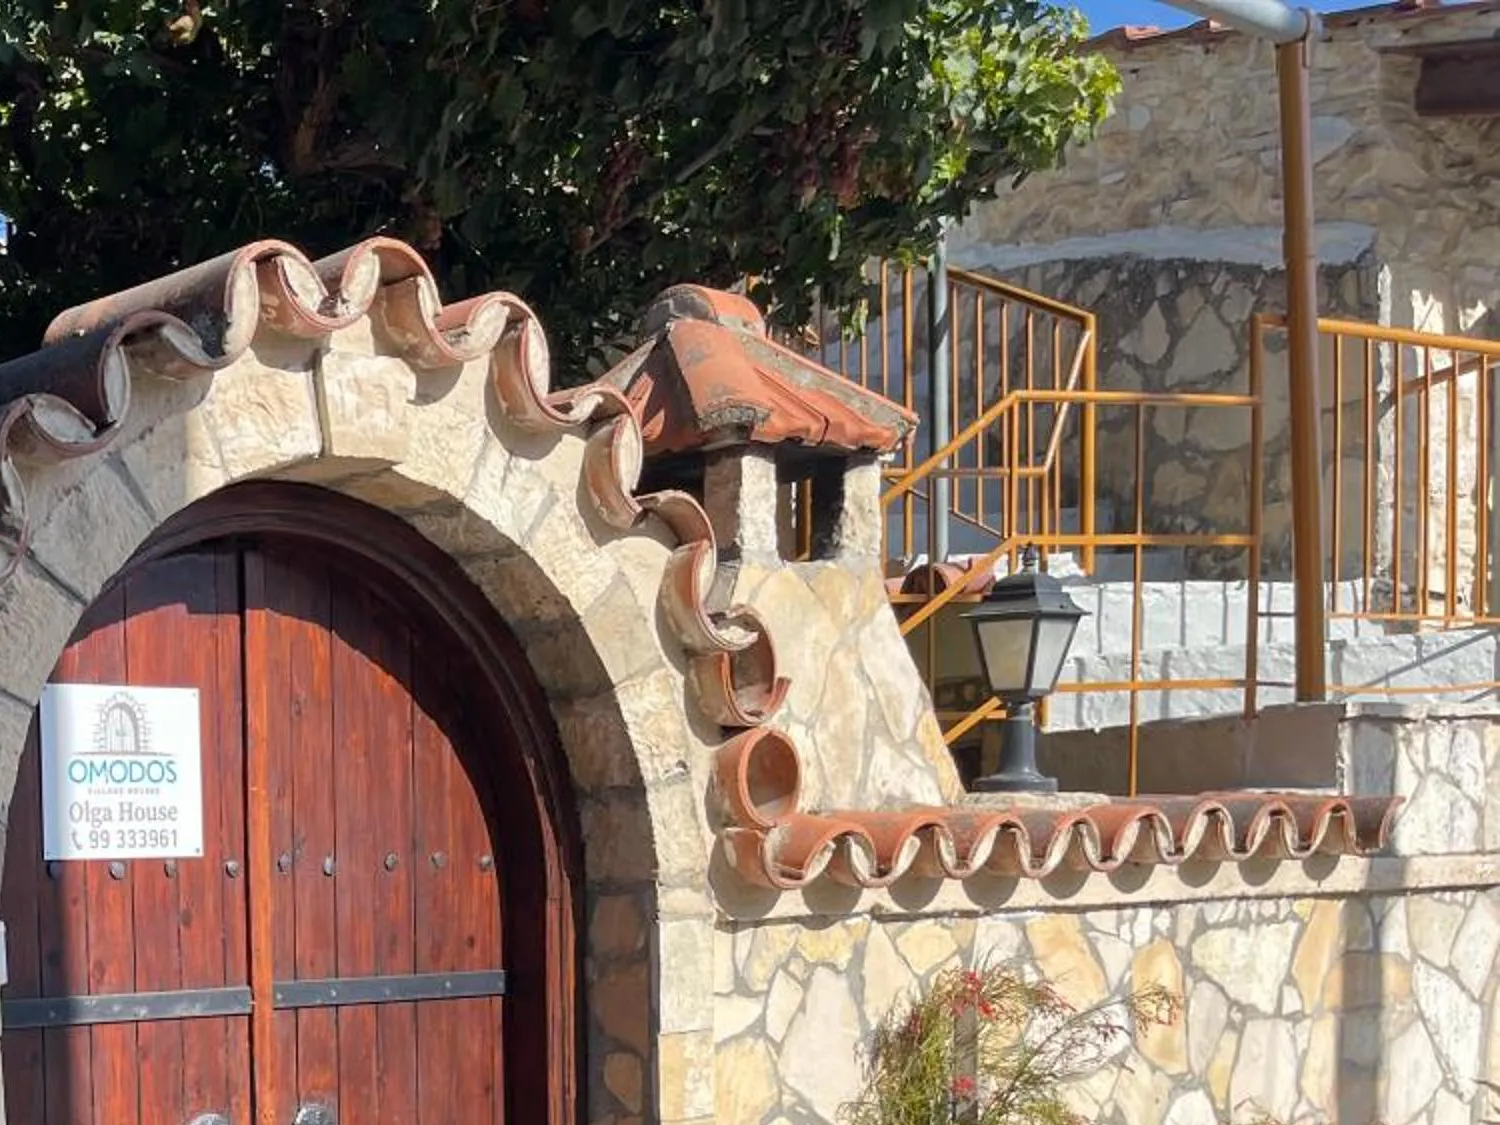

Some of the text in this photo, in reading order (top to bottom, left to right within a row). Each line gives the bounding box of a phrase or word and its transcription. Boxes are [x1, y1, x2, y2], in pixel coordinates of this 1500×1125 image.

[68, 759, 177, 784] OMODOS
[69, 800, 178, 828] Olga House
[89, 829, 178, 849] 99 333961
